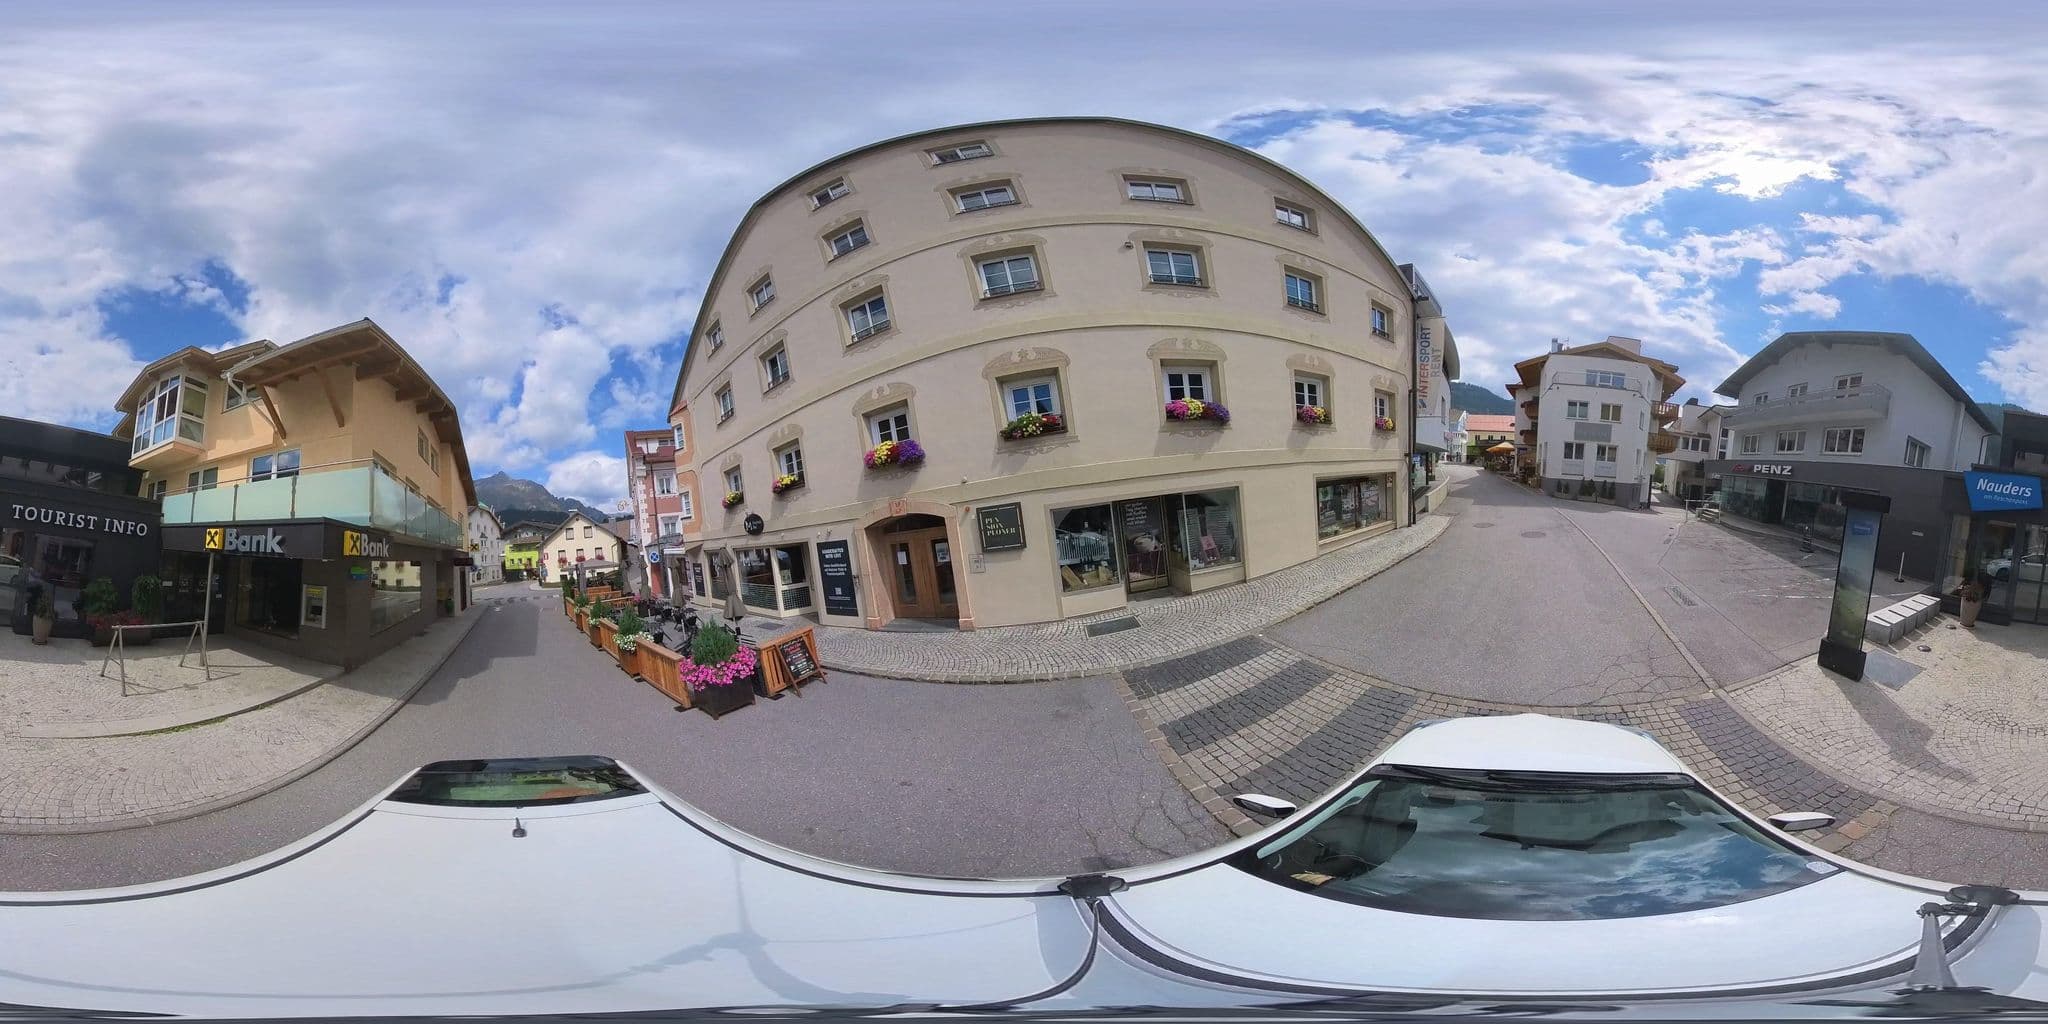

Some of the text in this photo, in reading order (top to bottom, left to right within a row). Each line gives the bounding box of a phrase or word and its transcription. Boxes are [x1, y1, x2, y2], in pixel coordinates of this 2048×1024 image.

[1418, 326, 1431, 398] INTERSPORT
[1430, 347, 1442, 378] RENT
[1753, 464, 1792, 475] PENZ
[1976, 478, 2032, 497] Nauders
[12, 504, 148, 536] TOURIST INFO
[224, 528, 284, 553] Bank
[361, 534, 389, 558] Bank
